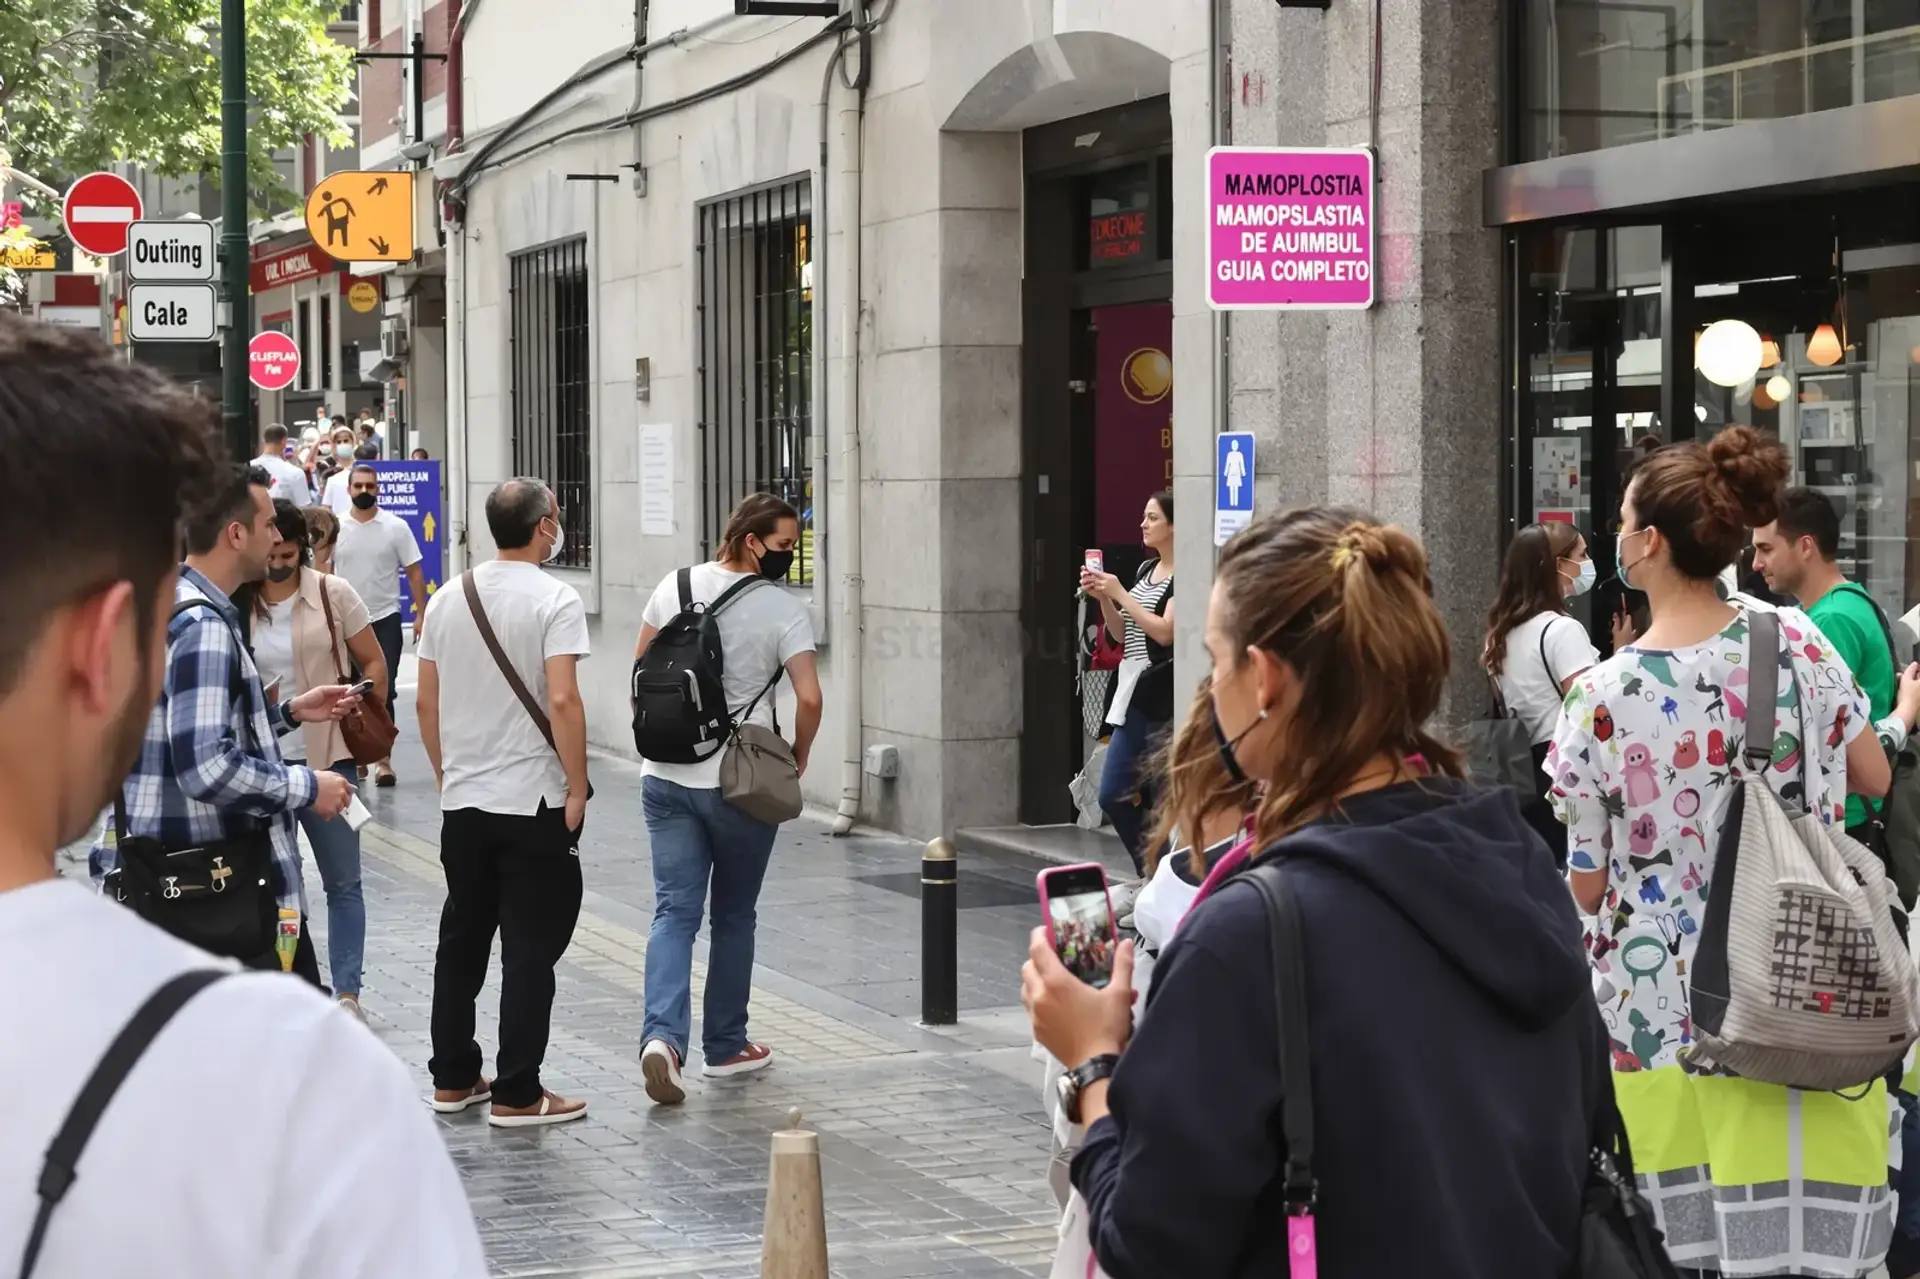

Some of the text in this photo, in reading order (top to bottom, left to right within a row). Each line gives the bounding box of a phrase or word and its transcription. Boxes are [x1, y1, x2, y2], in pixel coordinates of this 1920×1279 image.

[1225, 174, 1363, 196] MAMOPLOSTIA
[1216, 204, 1365, 227] MAMOPSLASTIA
[136, 238, 202, 269] Outiing
[1241, 232, 1267, 253] DE
[1217, 260, 1369, 281] GUIA COMPLETO
